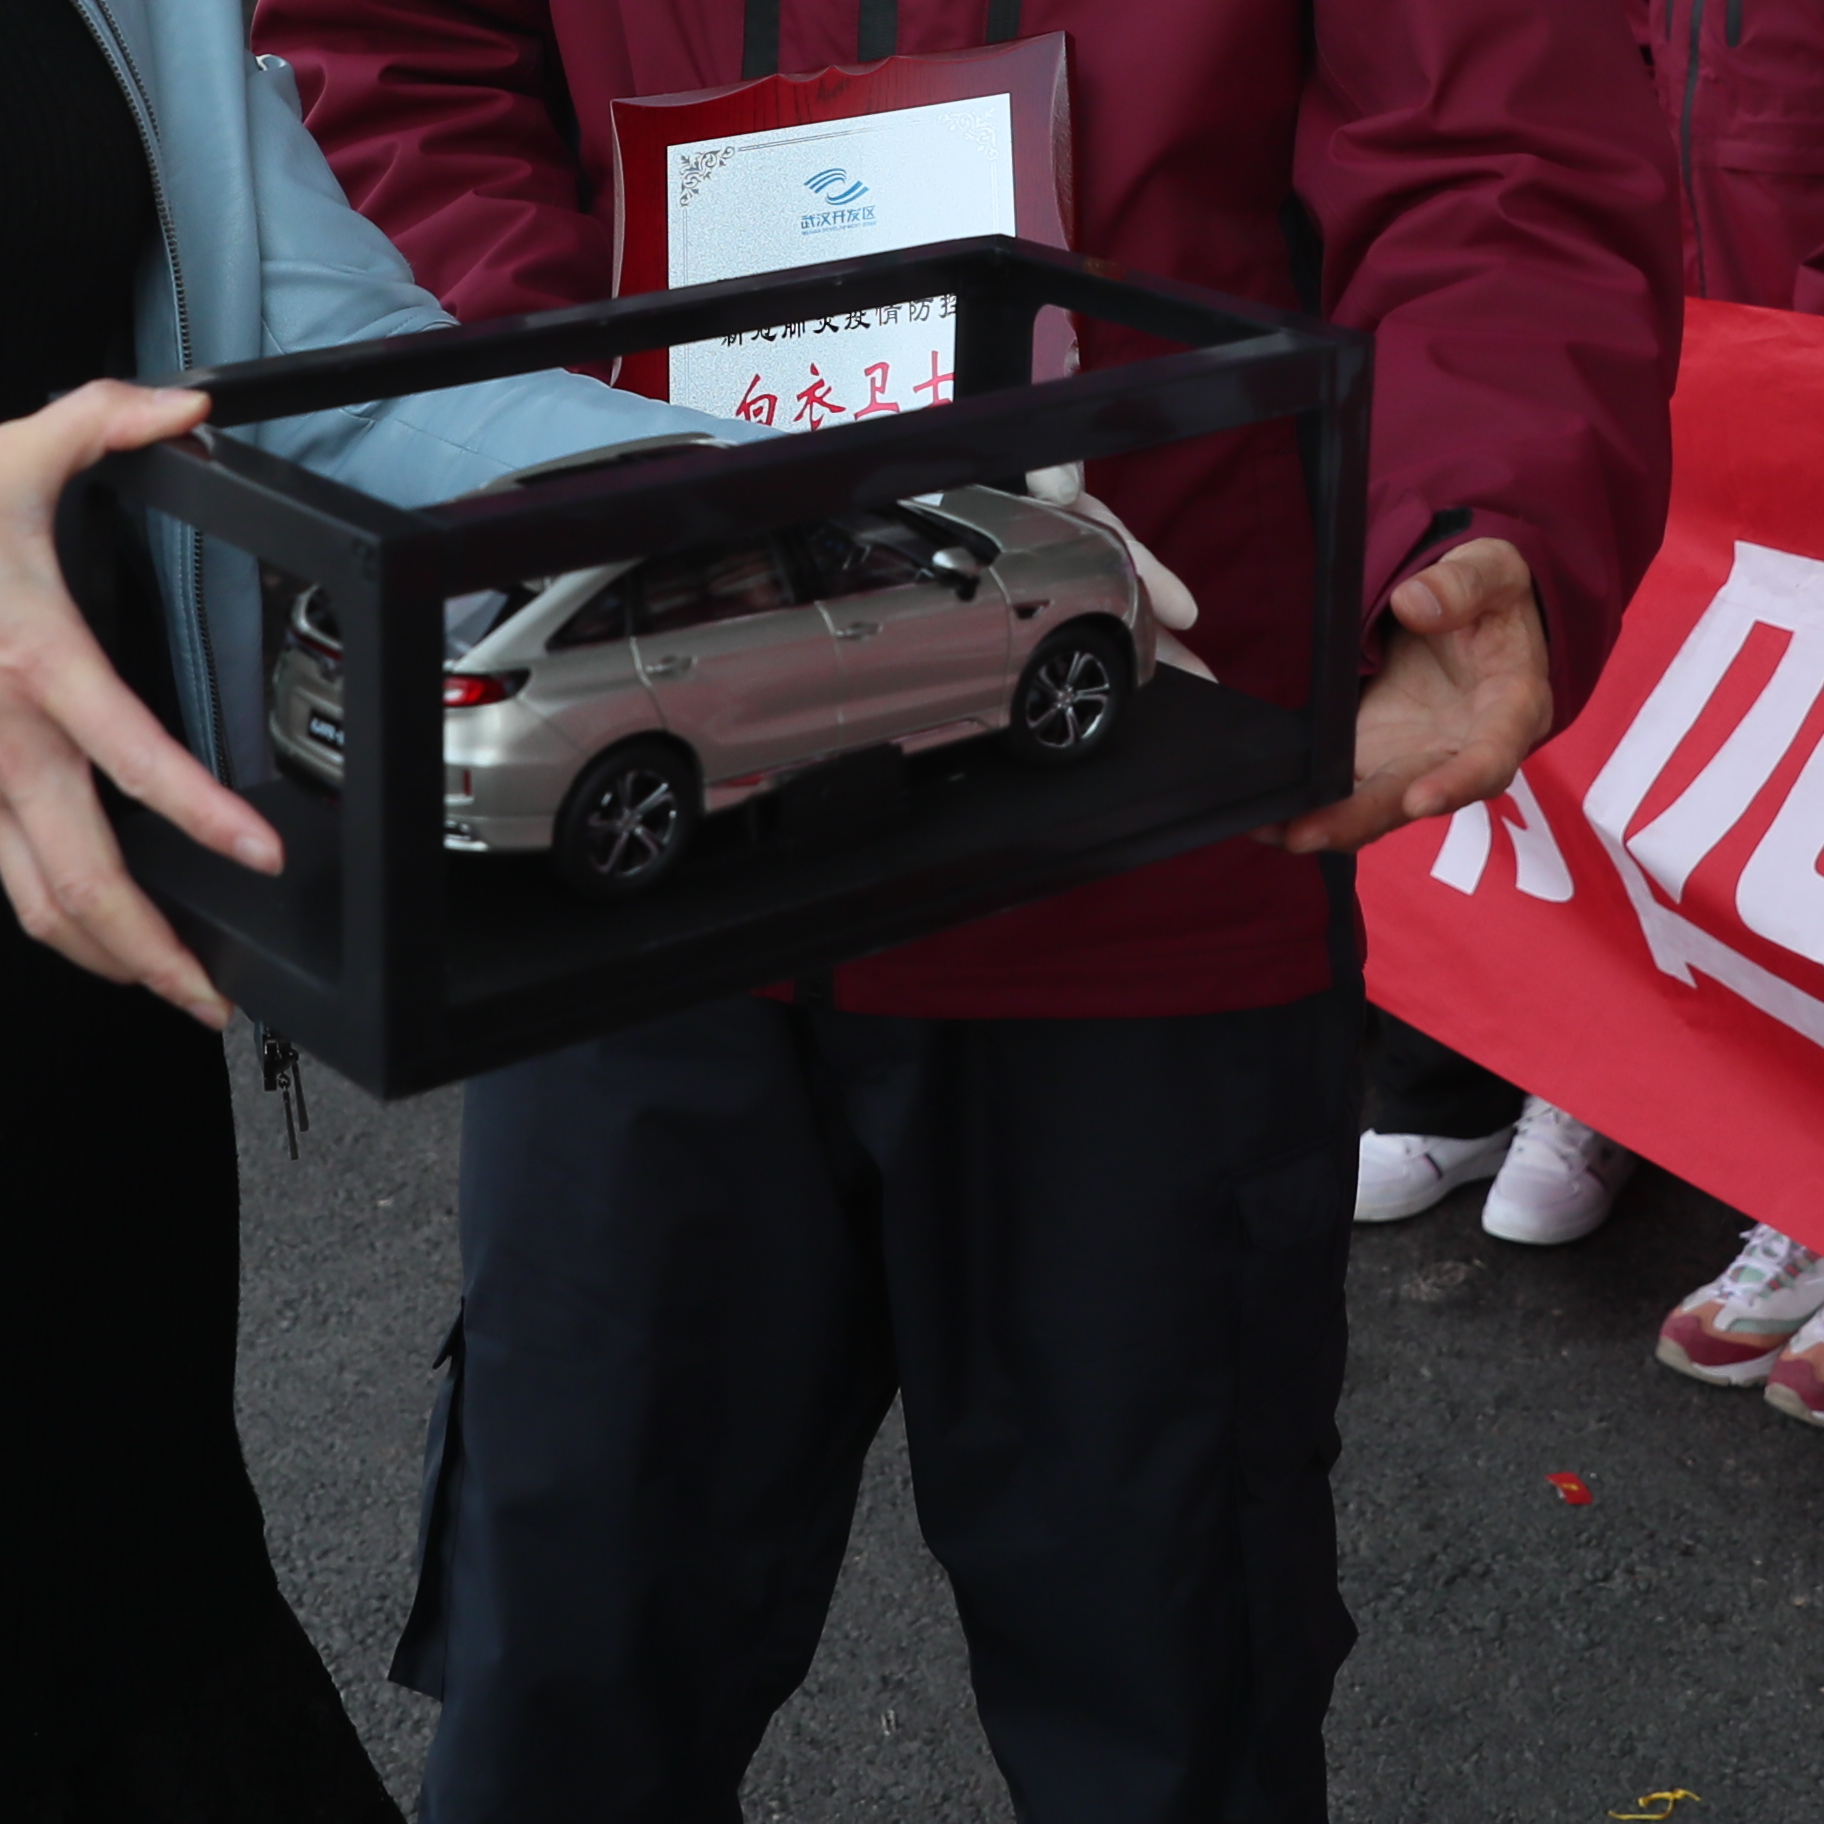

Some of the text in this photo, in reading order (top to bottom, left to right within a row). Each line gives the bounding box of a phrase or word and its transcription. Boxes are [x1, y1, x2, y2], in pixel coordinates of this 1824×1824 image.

[801, 205, 876, 229] 武汉开发区
[736, 350, 956, 432] 白衣卫士
